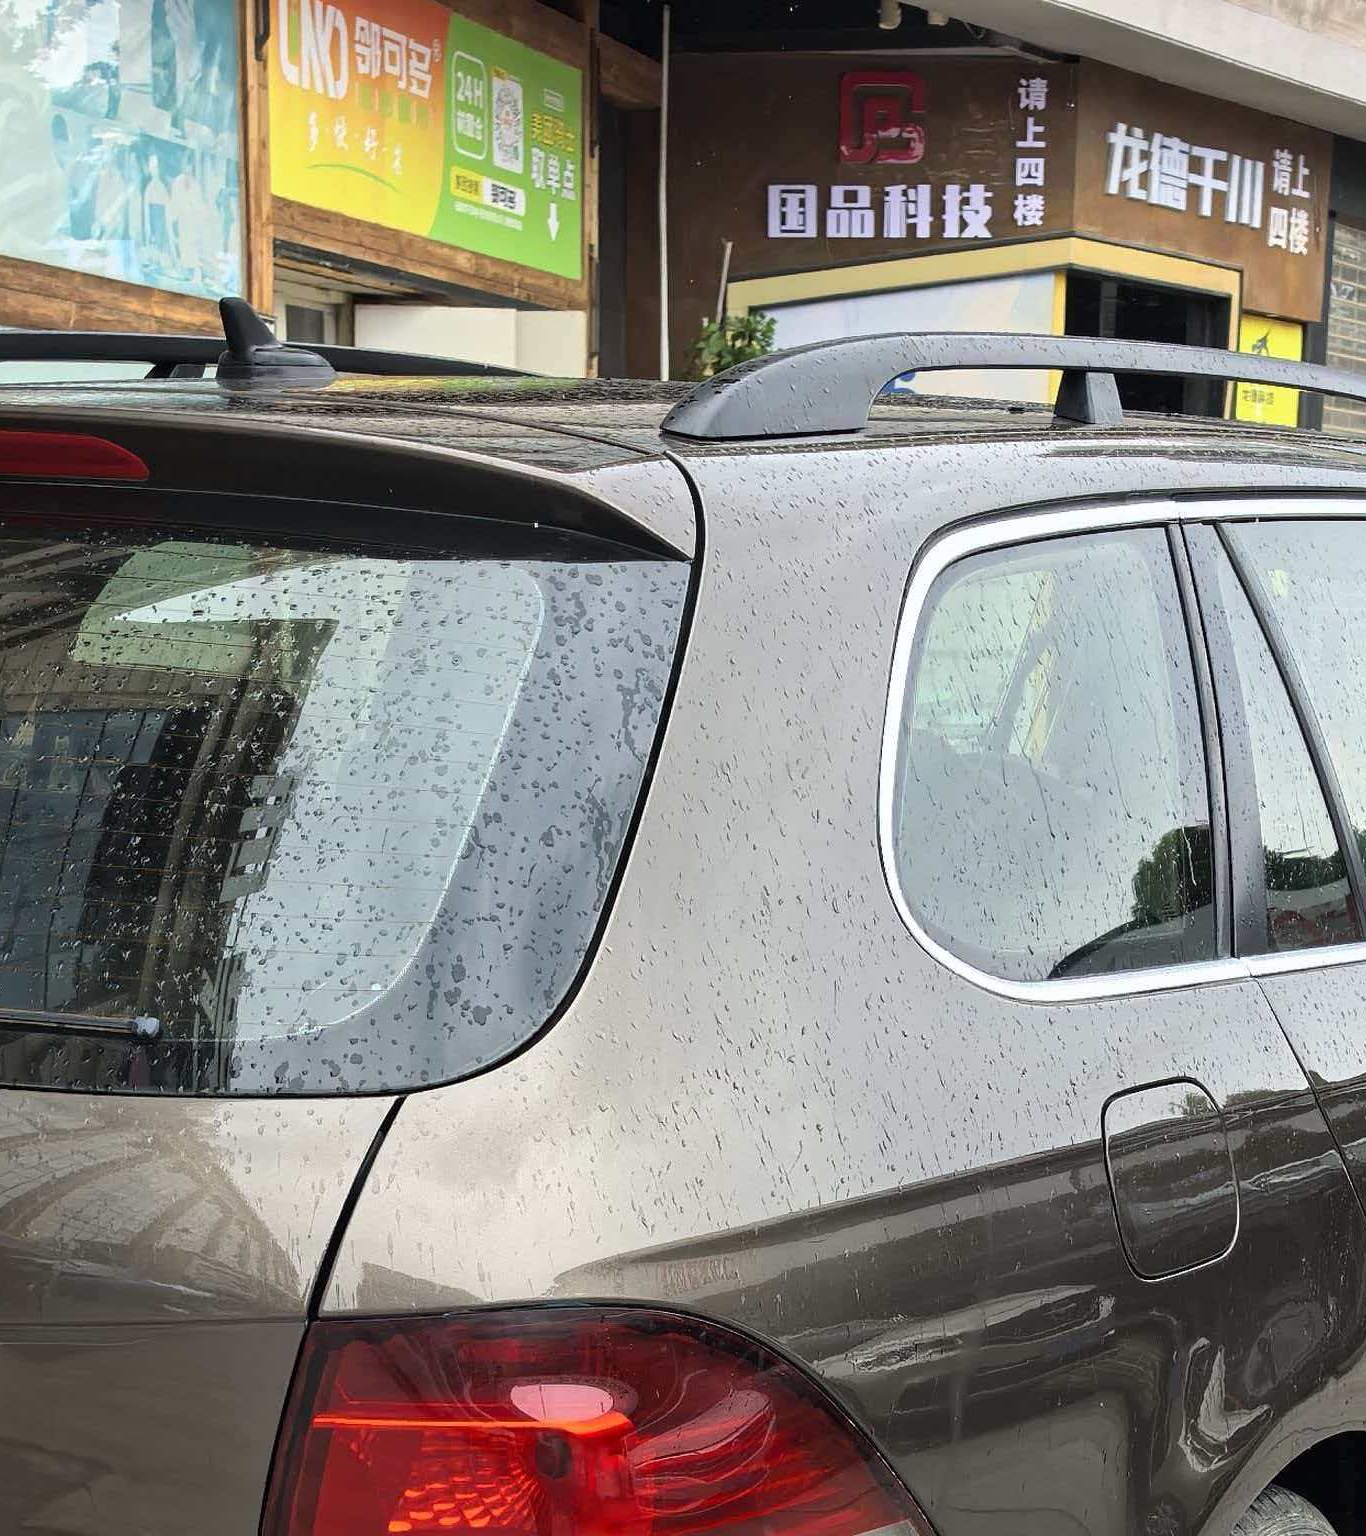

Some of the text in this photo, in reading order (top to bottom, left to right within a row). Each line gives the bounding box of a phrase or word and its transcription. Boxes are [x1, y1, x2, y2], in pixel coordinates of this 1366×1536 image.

[456, 70, 484, 109] 24H
[1013, 77, 1049, 227] 请上四楼
[767, 184, 995, 239] 国品科技
